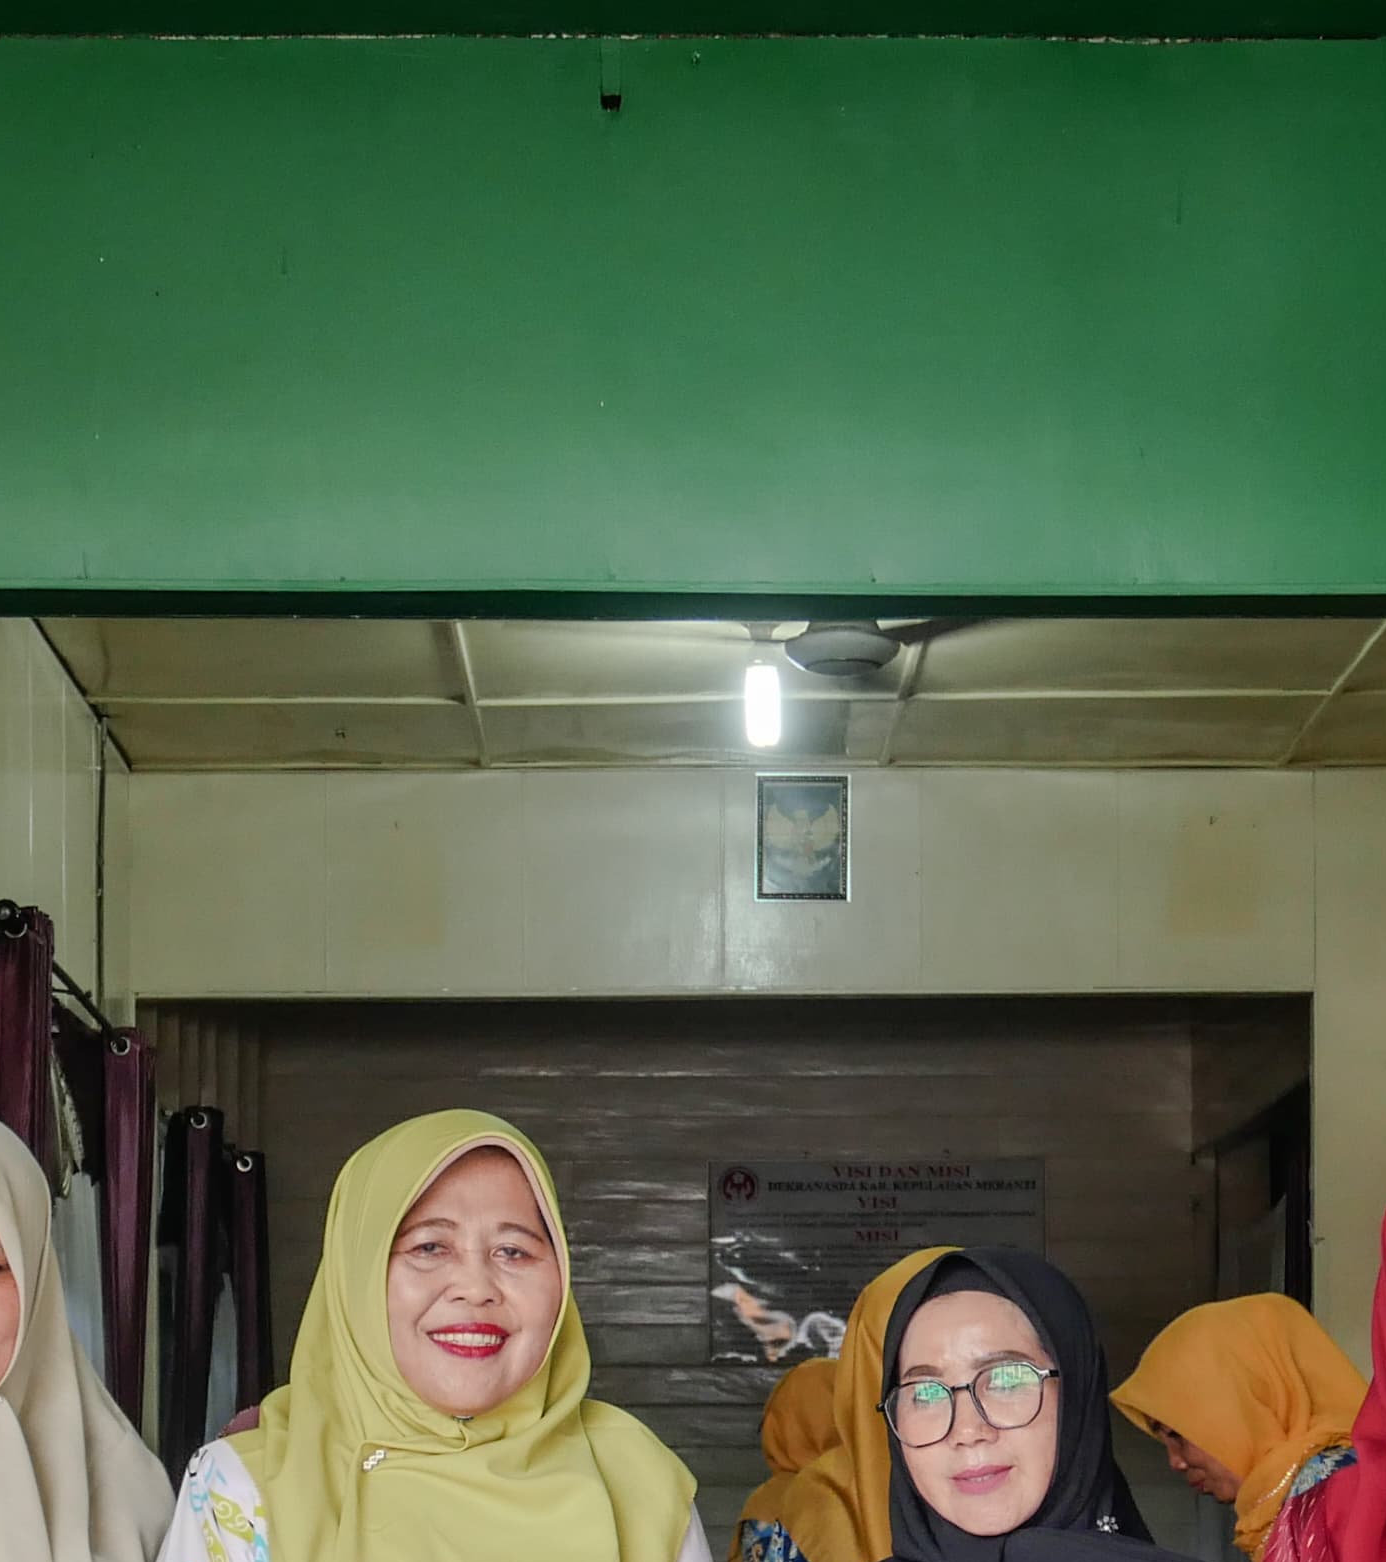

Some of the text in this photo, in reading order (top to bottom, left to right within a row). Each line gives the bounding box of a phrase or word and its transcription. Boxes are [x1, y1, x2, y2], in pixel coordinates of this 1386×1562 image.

[832, 1165, 971, 1178] VISI DAN MISI
[768, 1181, 856, 1192] DEKRANASDA
[892, 1180, 973, 1192] KEPULAUAN
[975, 1180, 1037, 1192] MERANTI
[857, 1197, 898, 1209] VISI
[854, 1231, 900, 1243] MISI
